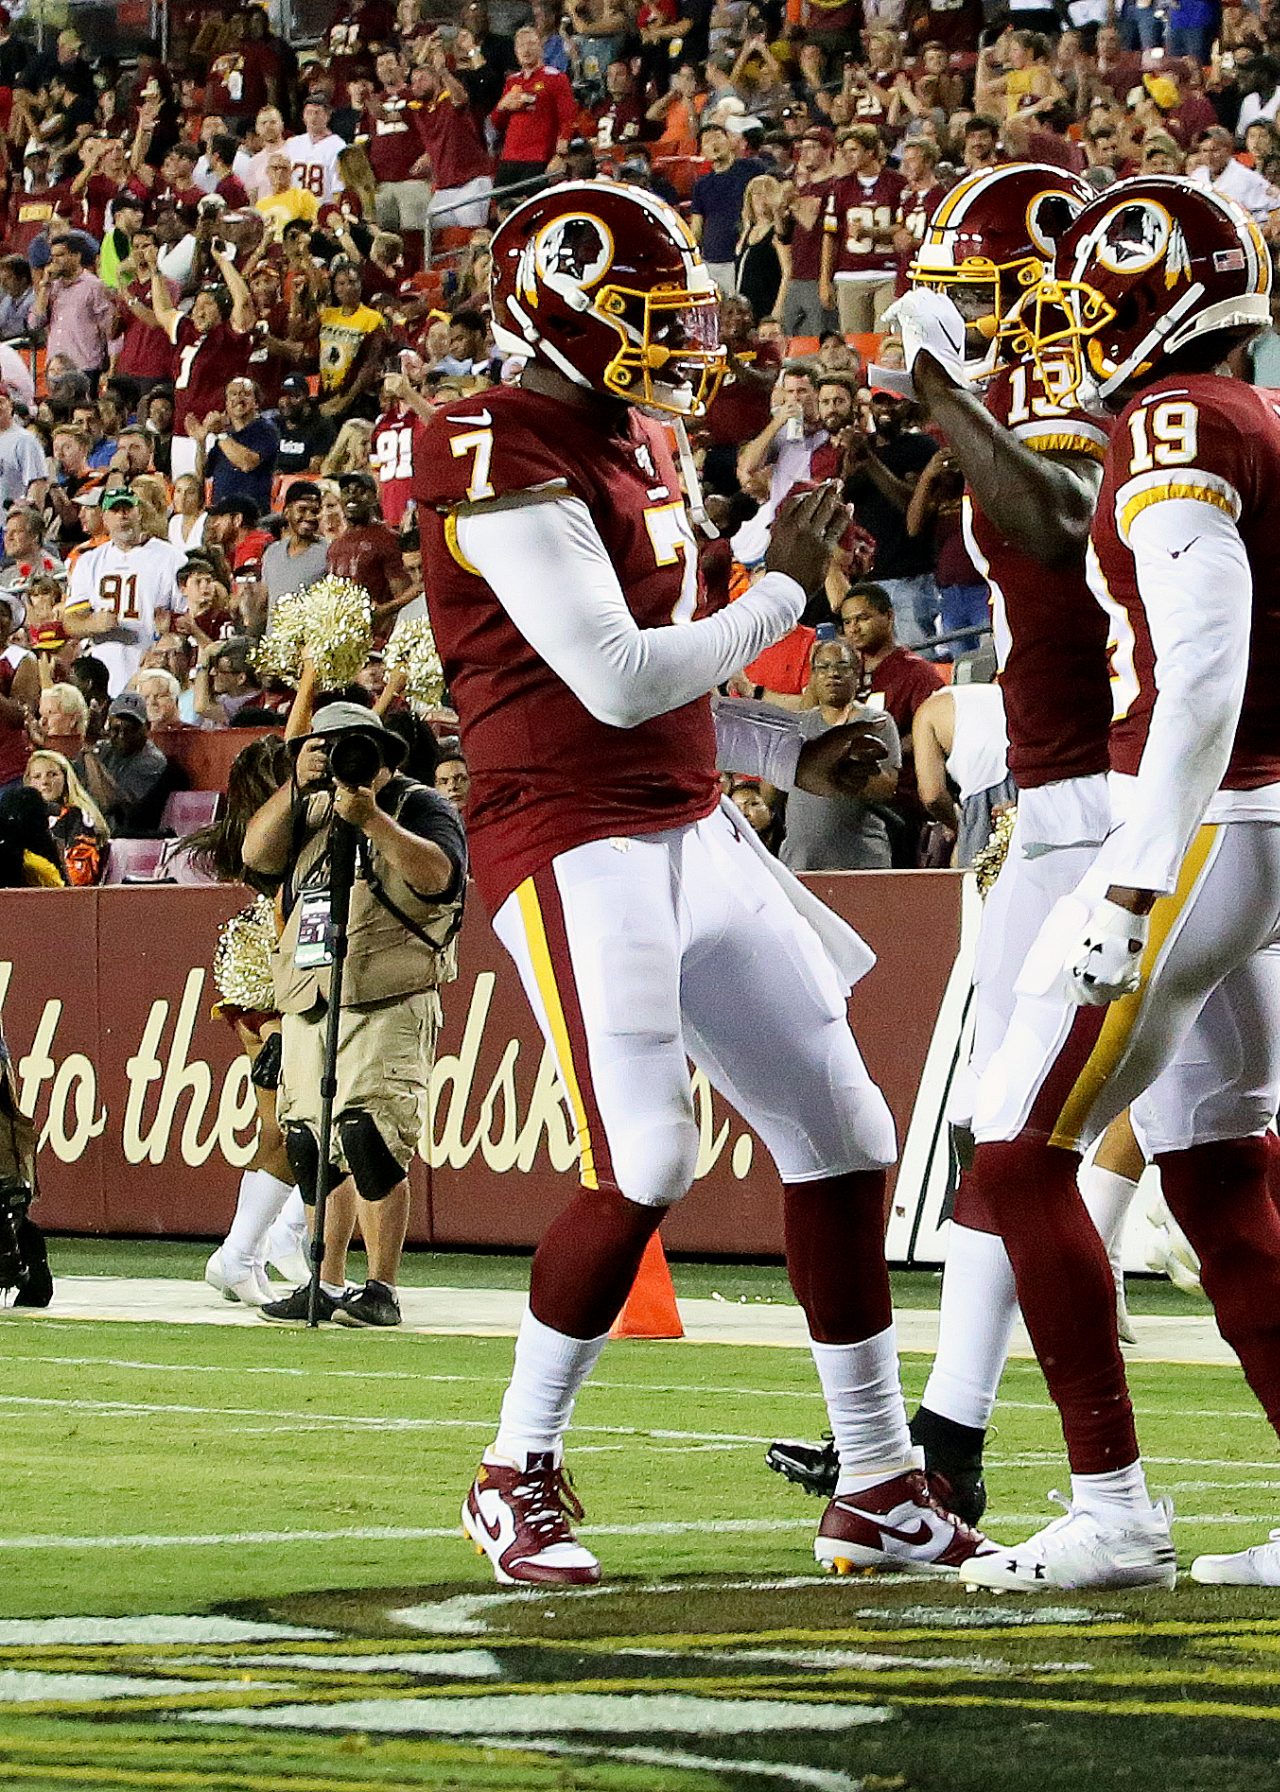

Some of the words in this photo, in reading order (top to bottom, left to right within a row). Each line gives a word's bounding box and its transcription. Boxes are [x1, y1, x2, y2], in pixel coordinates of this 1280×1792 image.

[376, 427, 413, 482] 91
[449, 427, 496, 503] 7
[1128, 400, 1199, 476] 19
[99, 573, 139, 619] 91
[643, 499, 699, 625] 7
[19, 999, 108, 1164] to
[122, 967, 262, 1168] the
